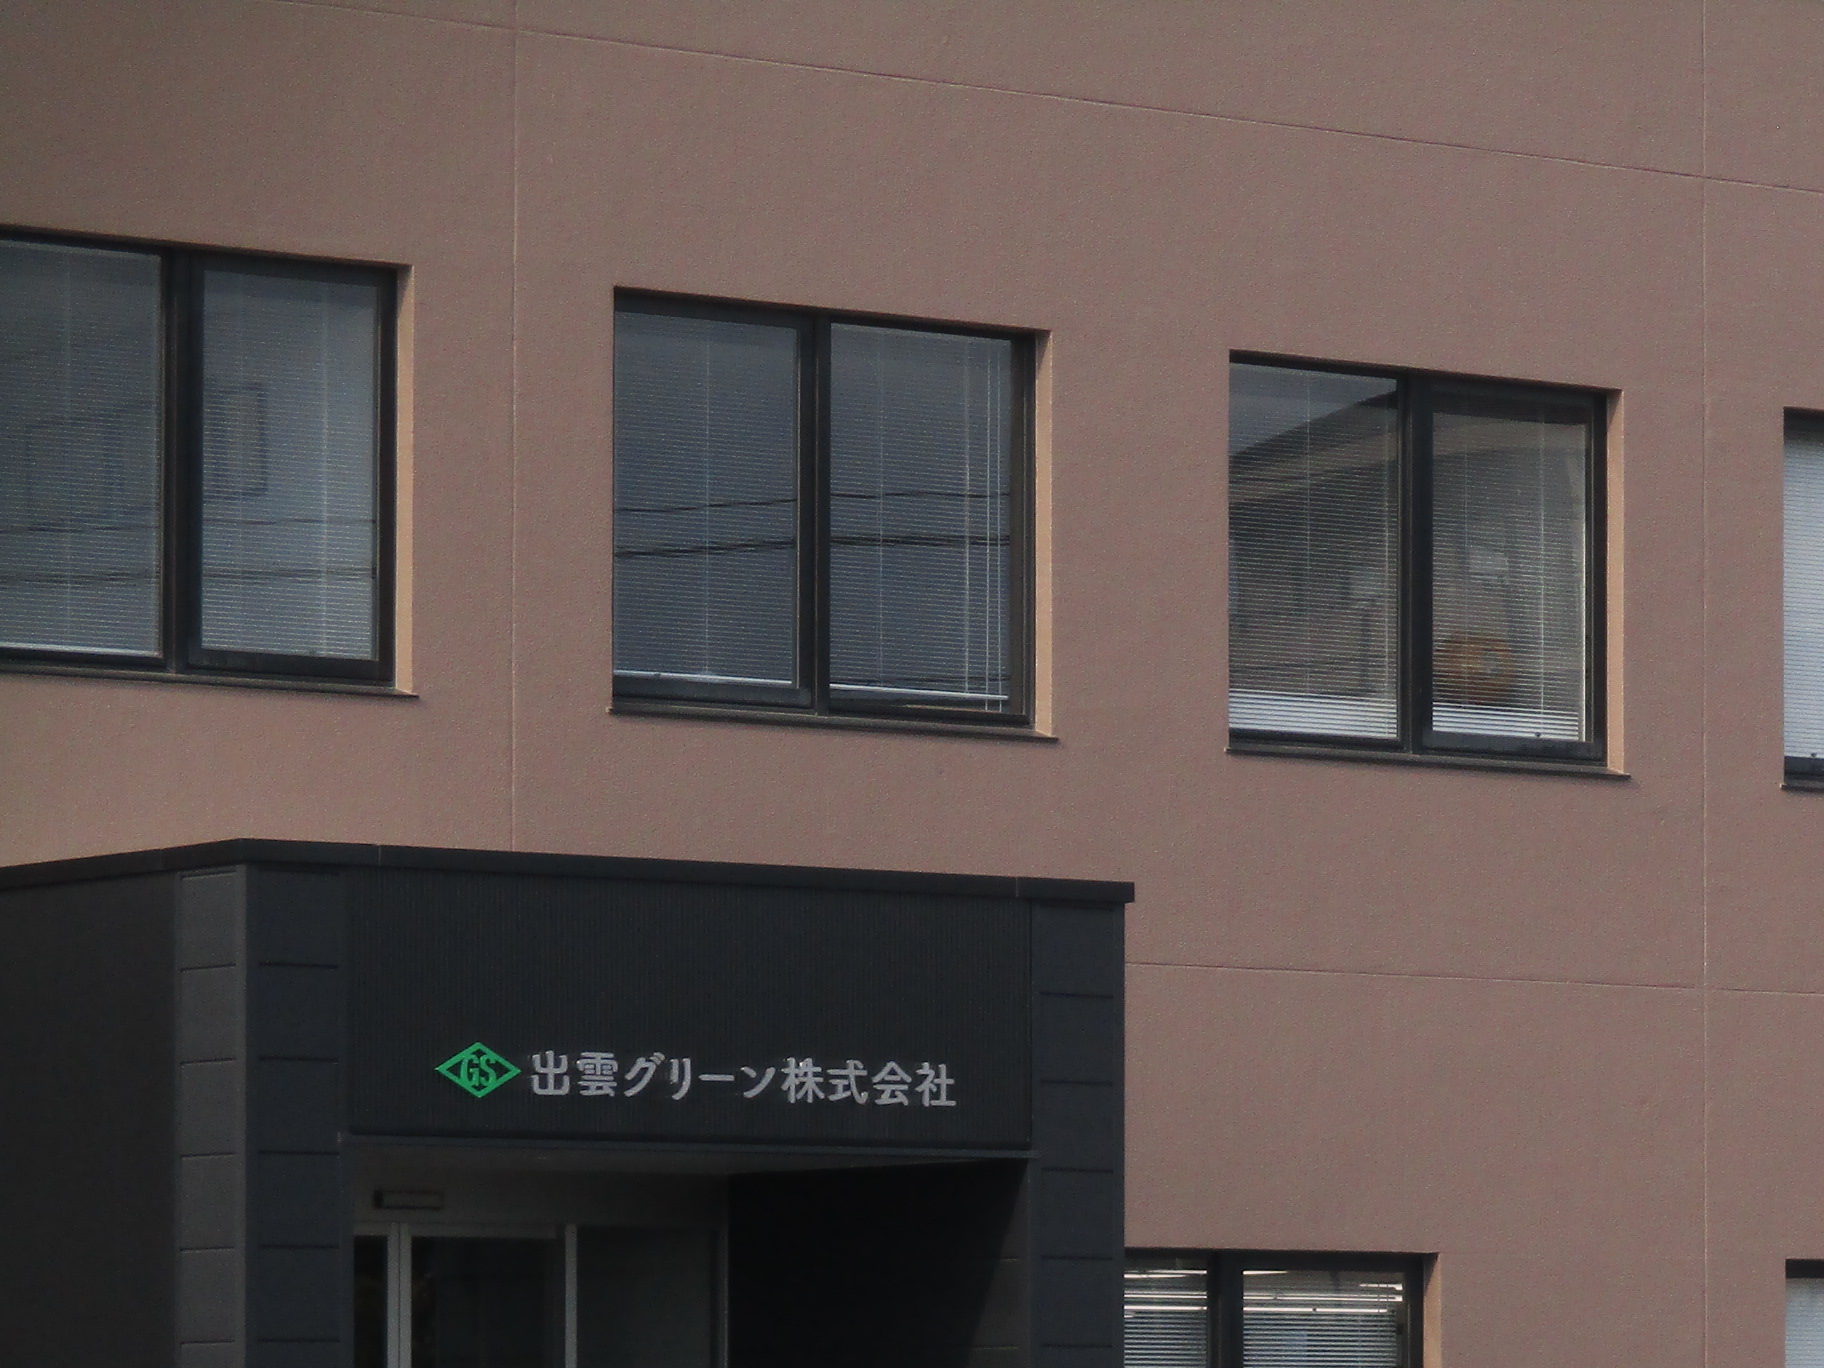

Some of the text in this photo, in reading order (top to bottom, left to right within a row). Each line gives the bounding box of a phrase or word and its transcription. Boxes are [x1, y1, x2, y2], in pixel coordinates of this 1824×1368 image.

[530, 1050, 957, 1108] 出雲グリーン株式会社
